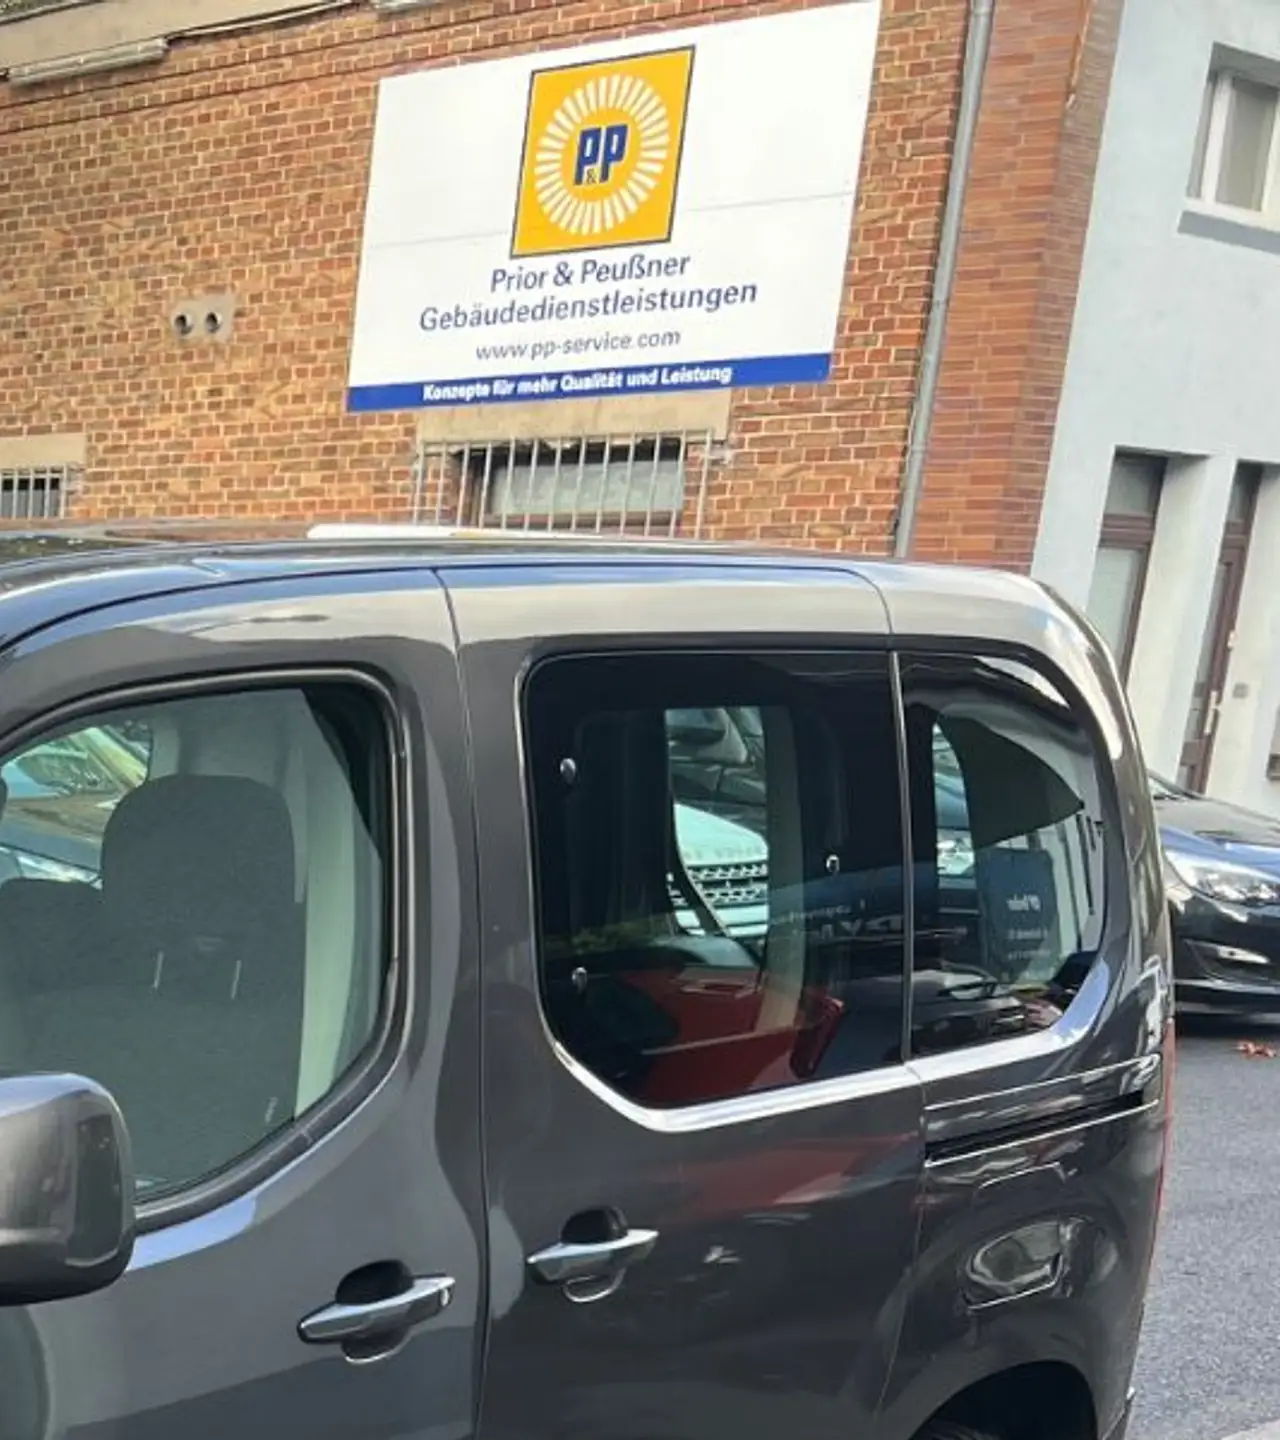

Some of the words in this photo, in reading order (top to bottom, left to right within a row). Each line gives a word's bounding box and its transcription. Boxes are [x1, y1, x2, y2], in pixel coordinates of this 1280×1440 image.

[490, 266, 548, 293] Prior
[553, 261, 574, 287] &
[580, 252, 691, 284] Peußner
[419, 283, 758, 331] Gebäudedienstleistungen
[476, 330, 681, 360] www.pp-service.com
[422, 383, 490, 401] Konzepte
[492, 378, 515, 396] für
[516, 374, 558, 394] mehr
[559, 369, 623, 392] Qualität
[625, 366, 658, 386] und
[660, 363, 733, 385] Leistung
